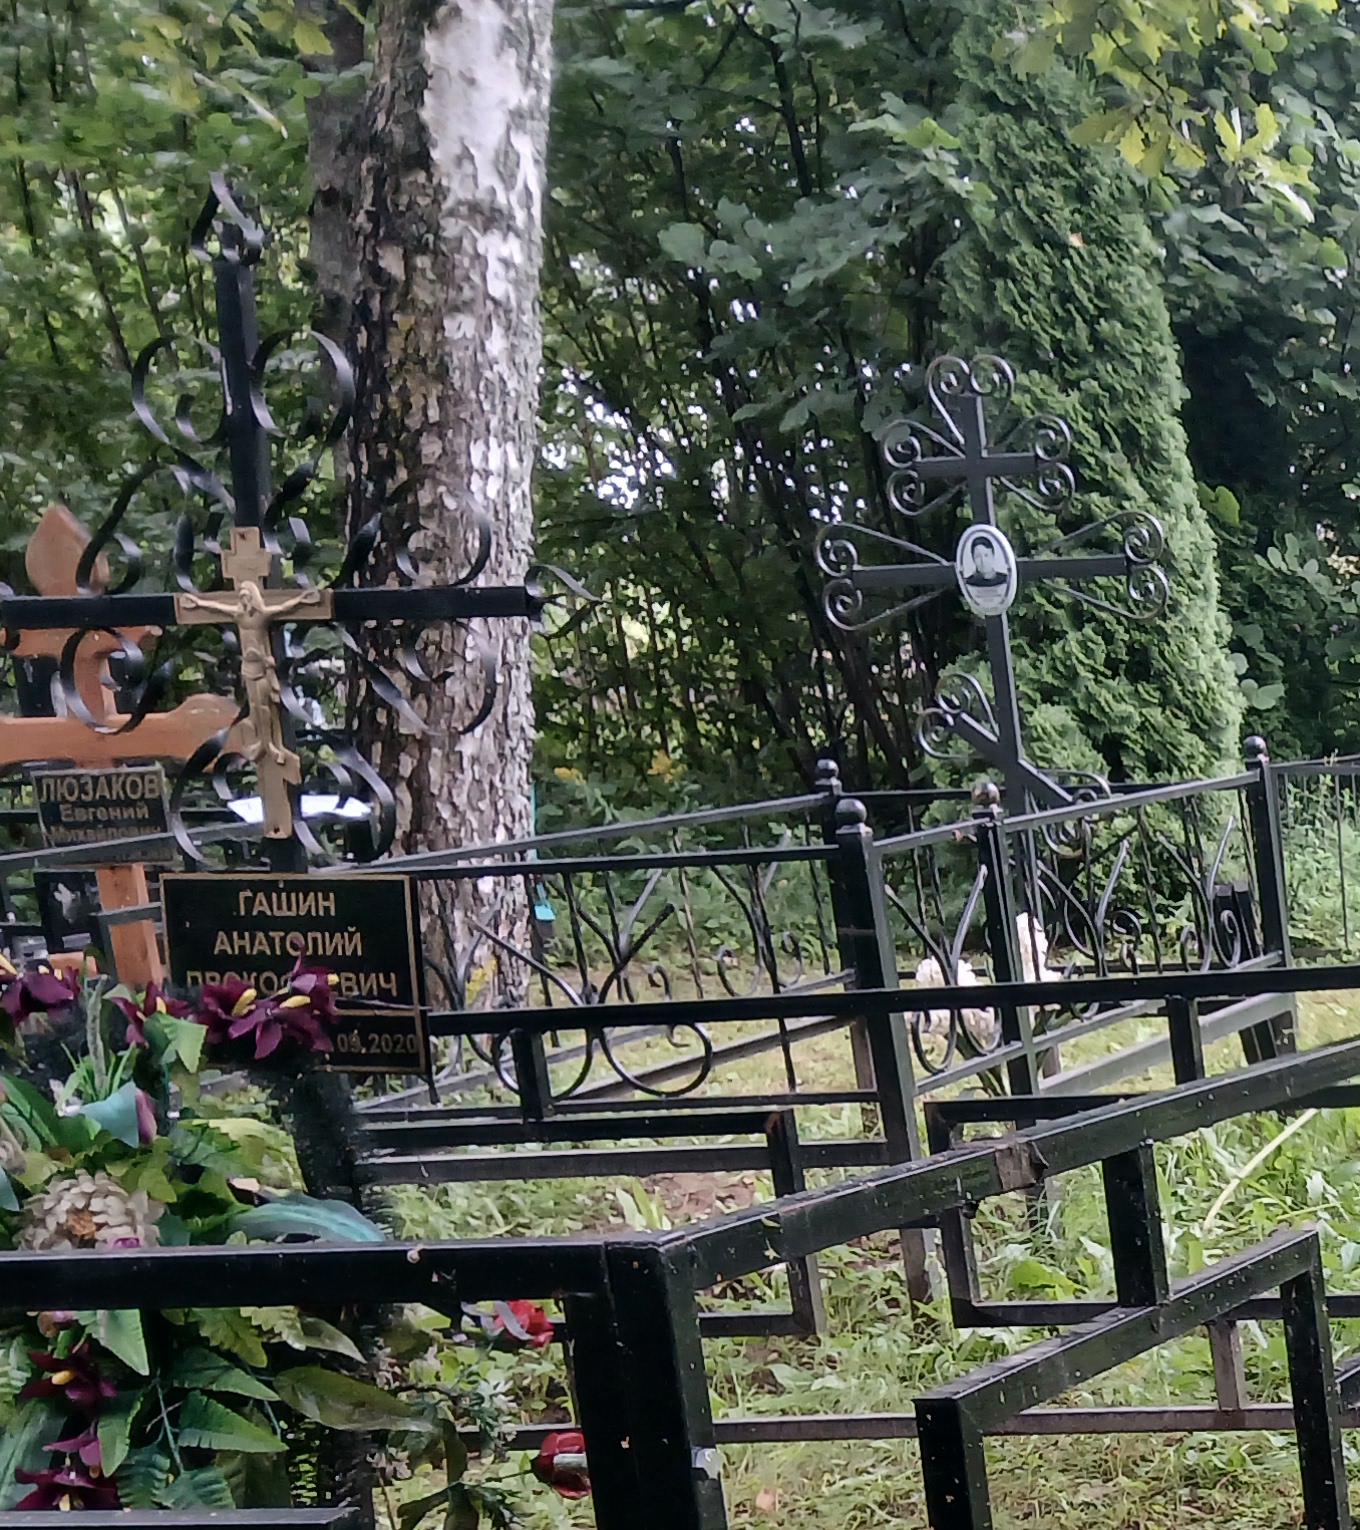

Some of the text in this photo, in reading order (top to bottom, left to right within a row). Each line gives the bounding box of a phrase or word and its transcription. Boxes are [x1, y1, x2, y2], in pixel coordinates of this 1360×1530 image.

[39, 773, 161, 803] ЛЮЗАКОВ
[59, 801, 149, 822] Евгений
[239, 889, 336, 917] ГАШИН
[213, 925, 363, 957] АНАТОЛИЙ
